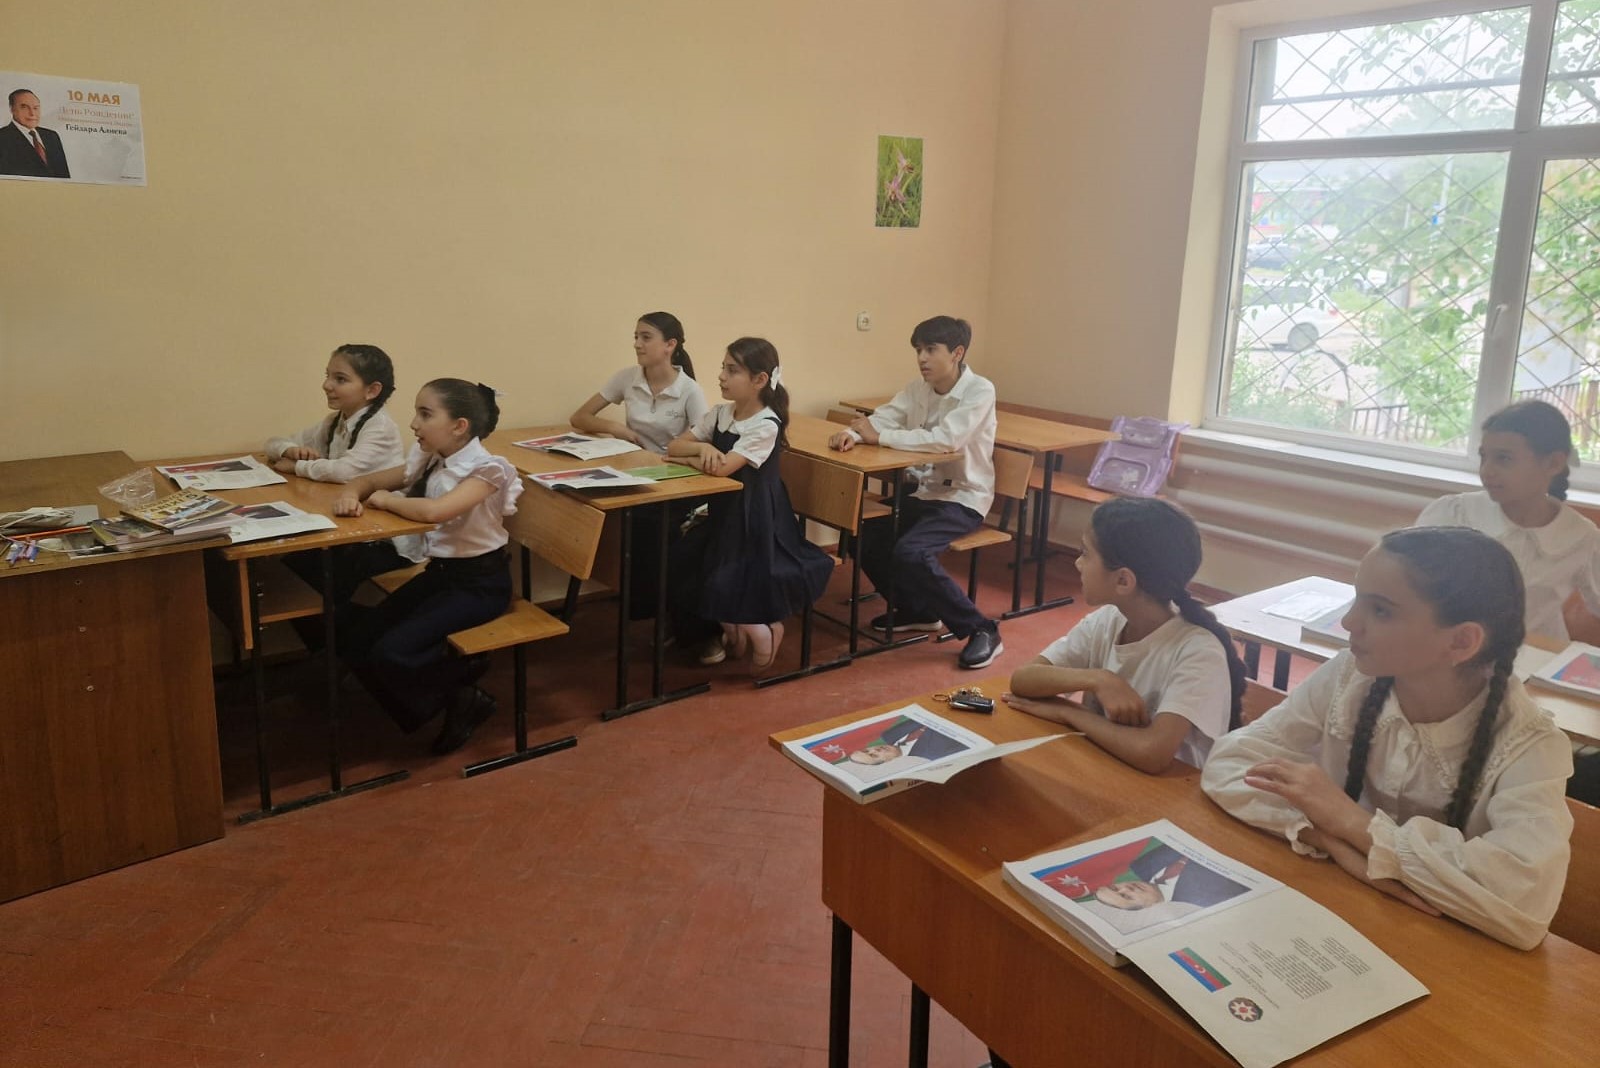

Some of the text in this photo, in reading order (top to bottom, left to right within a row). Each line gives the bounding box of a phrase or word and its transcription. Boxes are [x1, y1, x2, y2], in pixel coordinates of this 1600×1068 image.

[67, 90, 121, 106] 10 МАЯ
[65, 123, 128, 136] Гейдара Алиева
